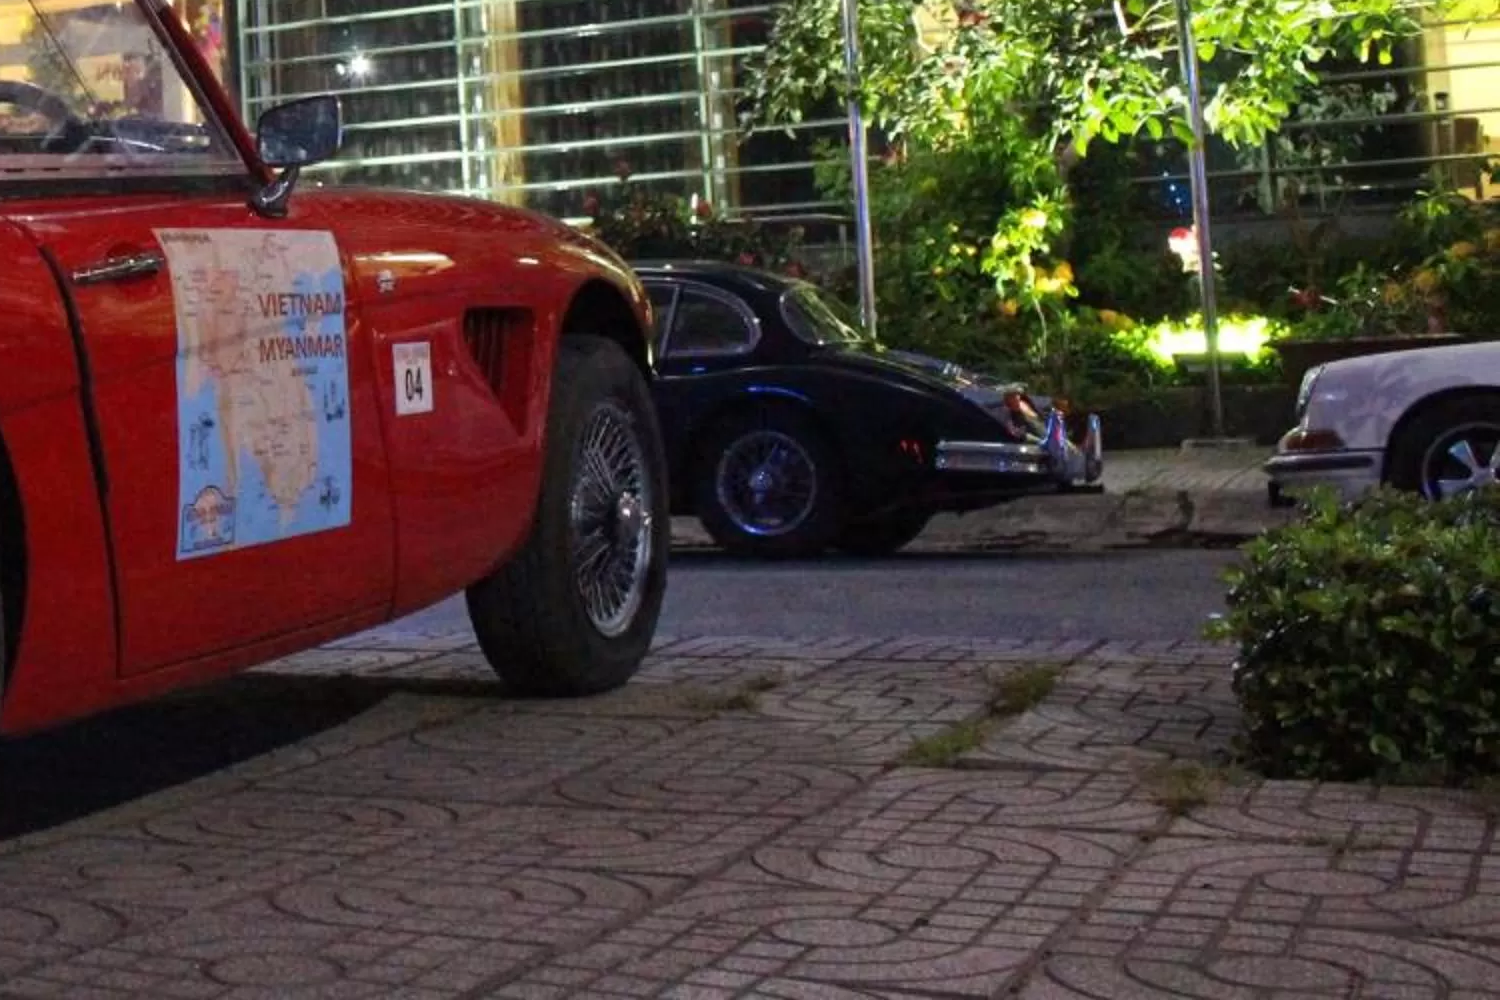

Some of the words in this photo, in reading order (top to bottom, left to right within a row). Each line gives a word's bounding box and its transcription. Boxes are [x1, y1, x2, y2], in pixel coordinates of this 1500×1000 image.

[258, 292, 341, 317] VIETNAM
[260, 333, 343, 364] MYANMAR
[405, 367, 424, 402] 04
